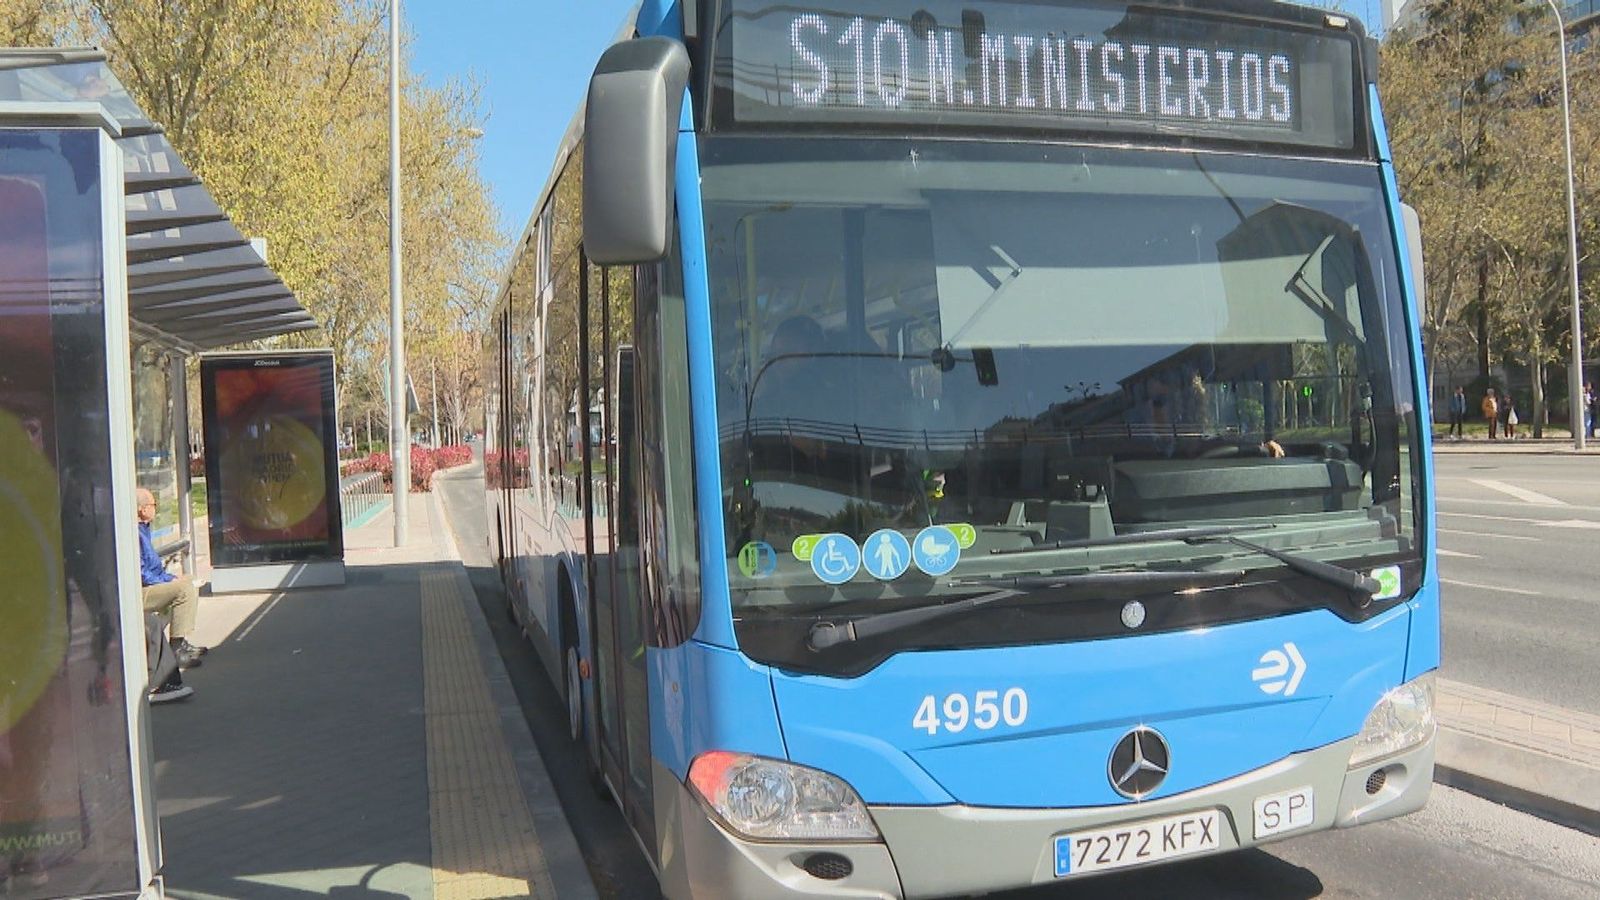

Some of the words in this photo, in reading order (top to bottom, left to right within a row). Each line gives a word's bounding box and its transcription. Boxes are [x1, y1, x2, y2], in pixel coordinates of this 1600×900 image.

[791, 14, 909, 107] S10
[799, 540, 810, 554] 2
[960, 527, 969, 541] 2
[912, 687, 1028, 735] 4950
[1263, 793, 1306, 830] SP
[1077, 829, 1150, 867] 7272
[1163, 816, 1213, 851] KFX
